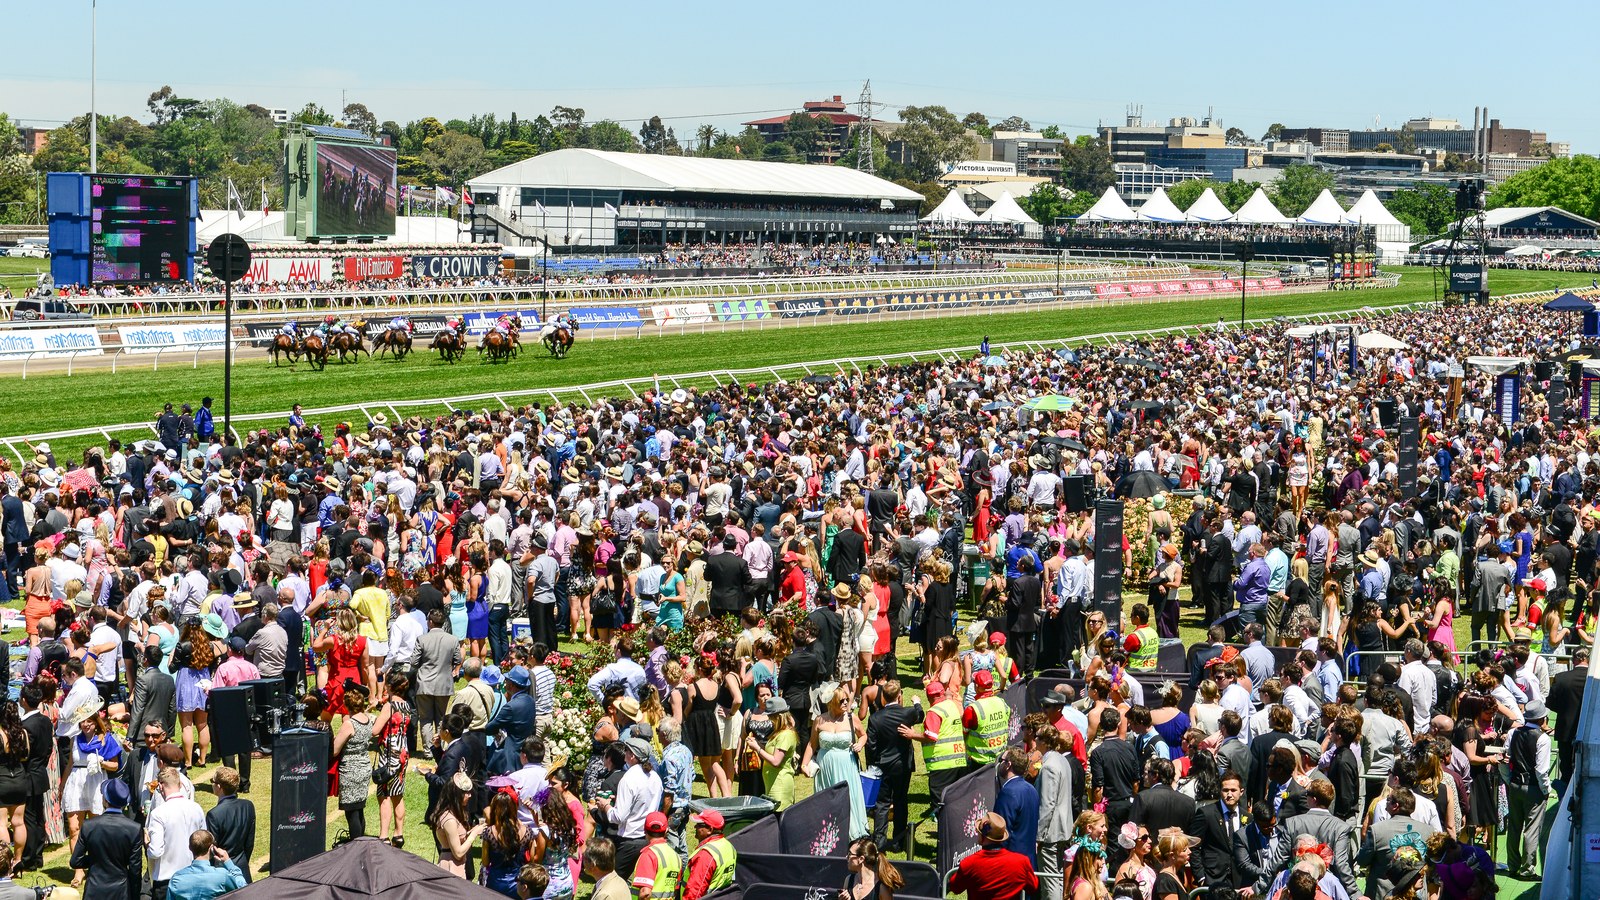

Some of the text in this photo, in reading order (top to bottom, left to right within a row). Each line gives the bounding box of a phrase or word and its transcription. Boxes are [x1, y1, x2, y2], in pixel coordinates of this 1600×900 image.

[763, 221, 843, 231] FLEMINGTON
[243, 260, 269, 281] AMI
[288, 260, 321, 281] AAMI
[355, 257, 395, 277] Fly Emirates
[429, 256, 482, 277] CROWN
[792, 301, 821, 312] LEXUS
[253, 328, 278, 338] JAMES
[989, 710, 1003, 722] ACG
[984, 719, 1007, 732] SECURITY
[279, 774, 308, 782] flemington
[277, 823, 306, 831] flemington
